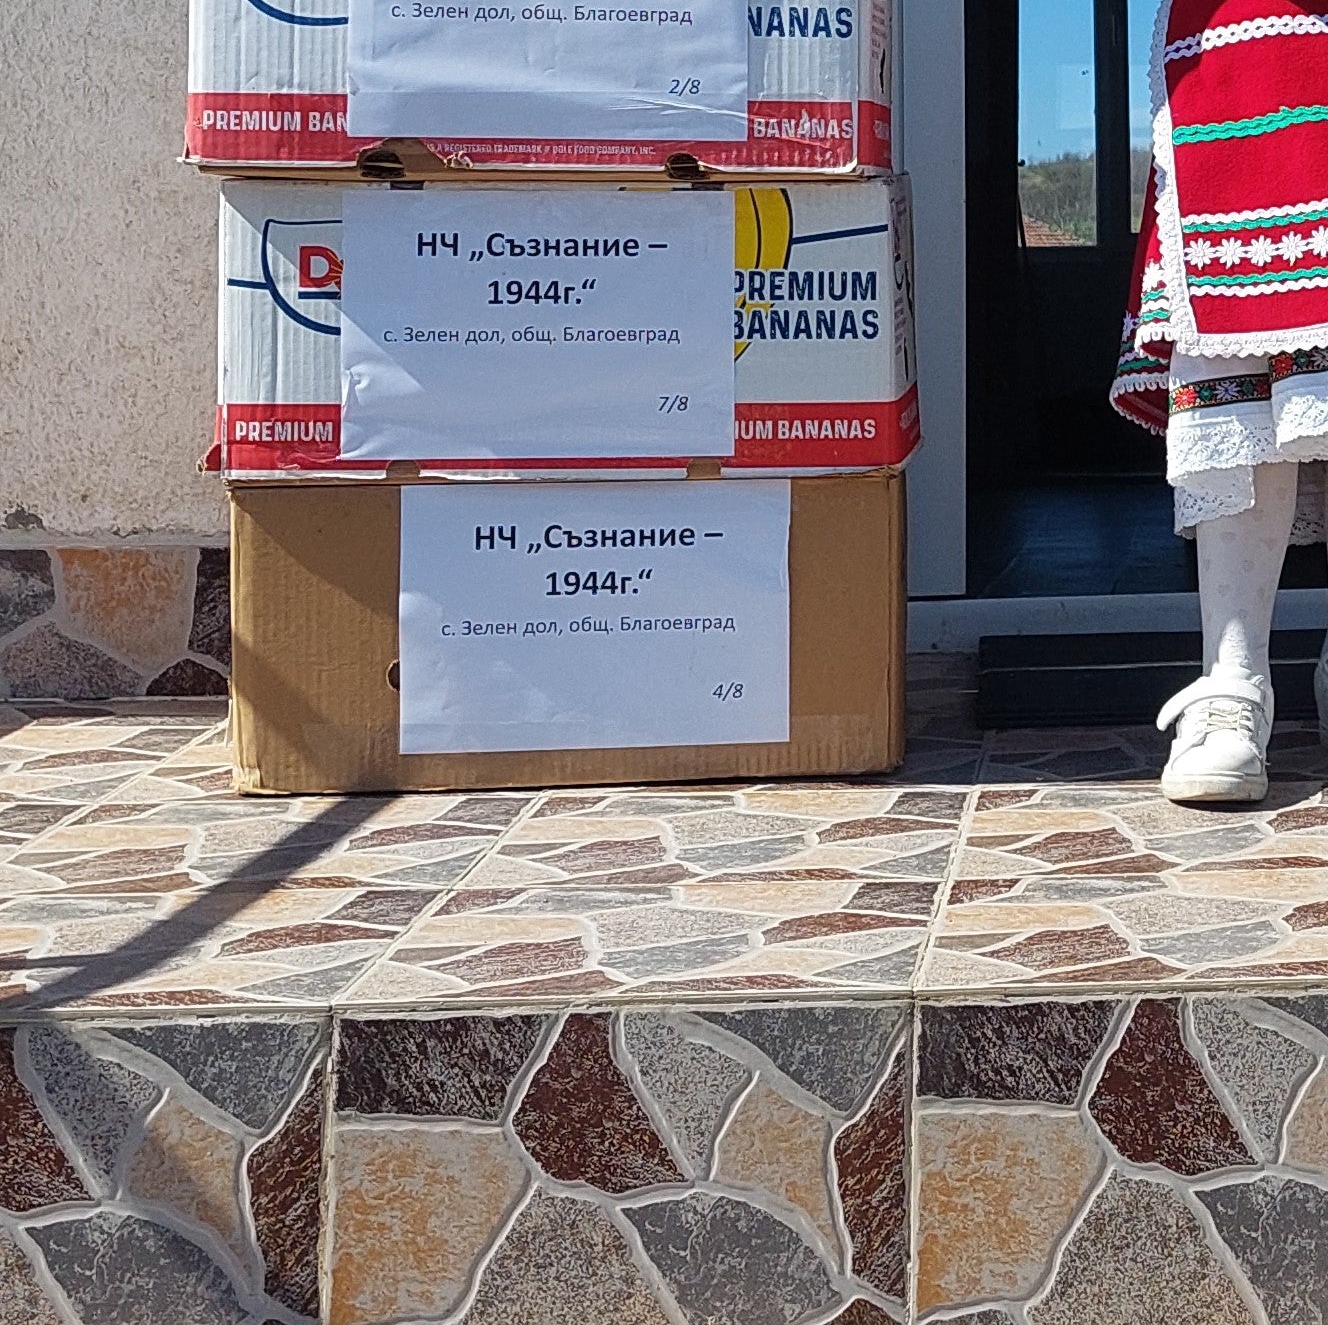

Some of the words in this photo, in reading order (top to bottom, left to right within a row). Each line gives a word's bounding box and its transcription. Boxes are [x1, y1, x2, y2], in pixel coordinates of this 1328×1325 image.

[391, 5, 406, 18] с.
[411, 2, 469, 19] Зелен
[473, 7, 516, 23] дол,
[521, 3, 568, 24] общ.
[574, 4, 693, 27] Благоевград
[748, 6, 853, 39] NANAS
[667, 77, 701, 98] 2/8
[202, 109, 302, 132] PREMIUM
[753, 118, 854, 139] BANANAS
[494, 144, 543, 154] TRADEMARK
[417, 232, 459, 257] НЧ
[383, 330, 398, 343] с.
[403, 326, 460, 343] Зелен
[464, 330, 506, 347] дол,
[511, 325, 557, 346] общ.
[563, 326, 681, 346] Благоевград
[658, 394, 689, 414] 7/8
[235, 420, 334, 442] PREMIUM
[777, 419, 877, 440] BANANAS
[475, 525, 517, 551] НЧ
[441, 624, 456, 637] с.
[461, 620, 517, 636] Зелен
[522, 621, 563, 638] дол,
[569, 615, 614, 636] общ.
[620, 616, 736, 634] Благоевград
[712, 681, 744, 702] 4/8
